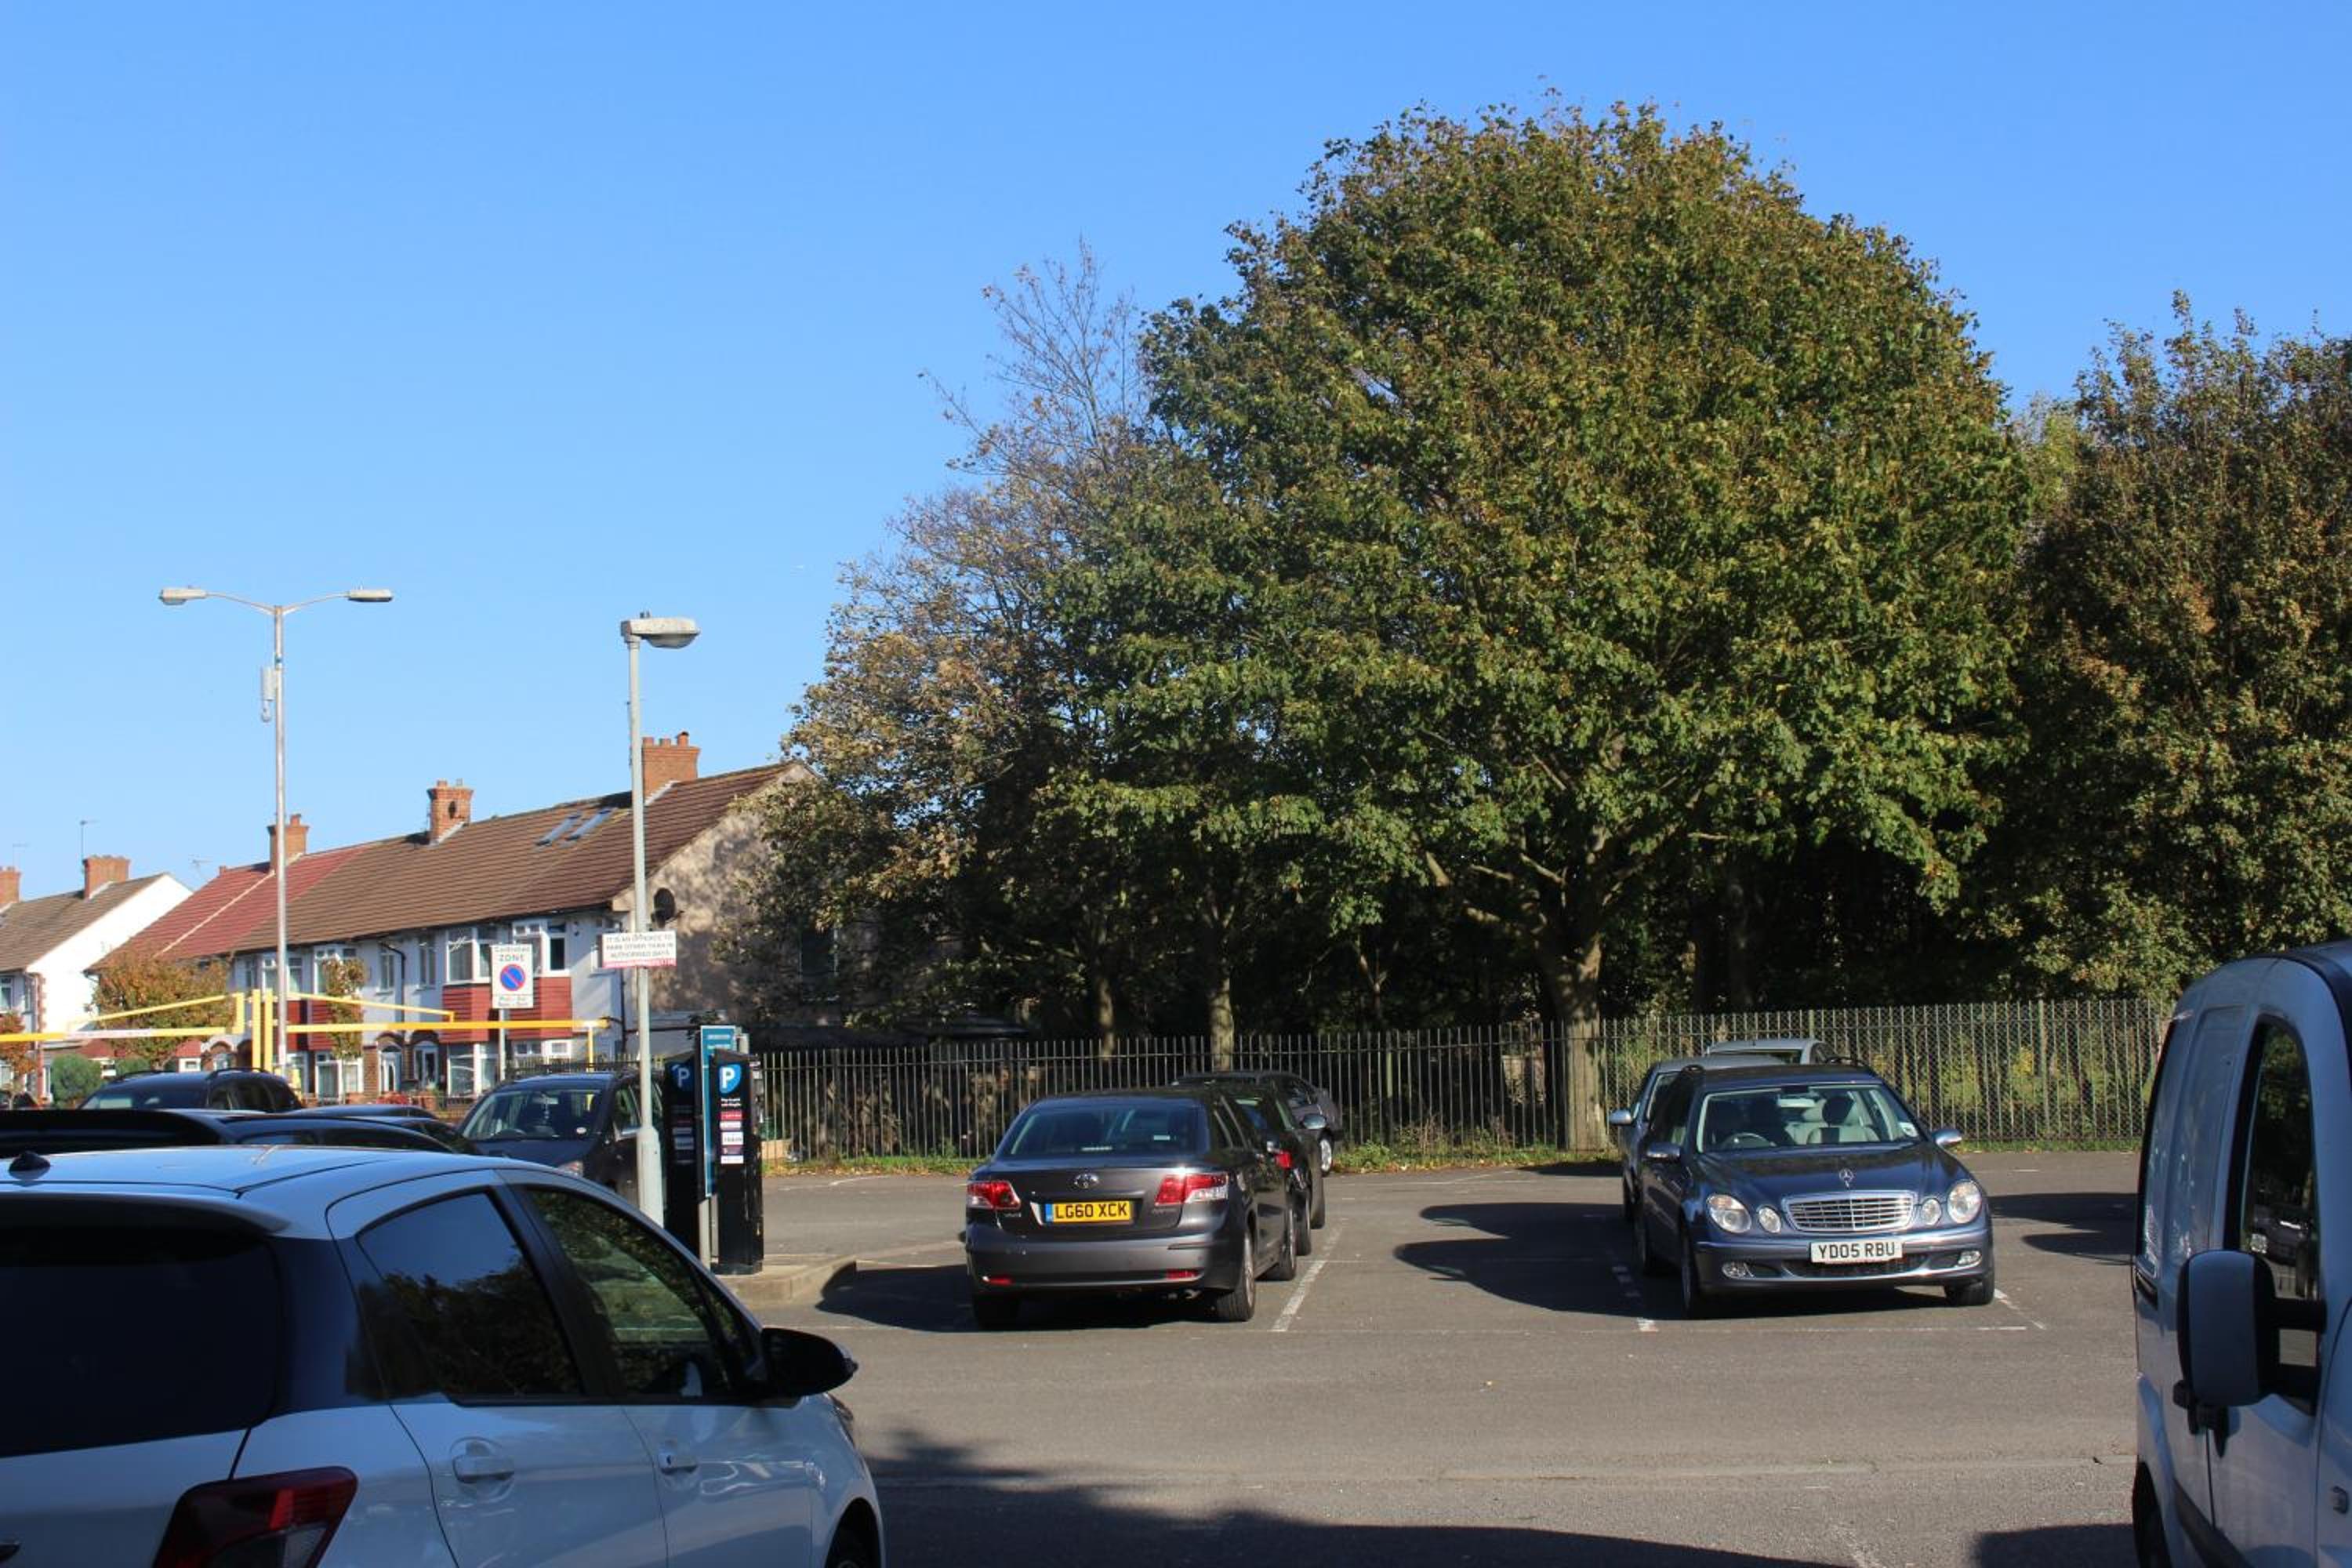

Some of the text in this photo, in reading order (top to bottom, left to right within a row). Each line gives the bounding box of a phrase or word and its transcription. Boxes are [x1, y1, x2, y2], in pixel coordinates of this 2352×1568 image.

[677, 1066, 690, 1089] P
[722, 1067, 735, 1089] P
[1054, 1203, 1128, 1220] LG60 XCK
[1818, 1241, 1895, 1259] YD05 RBU
